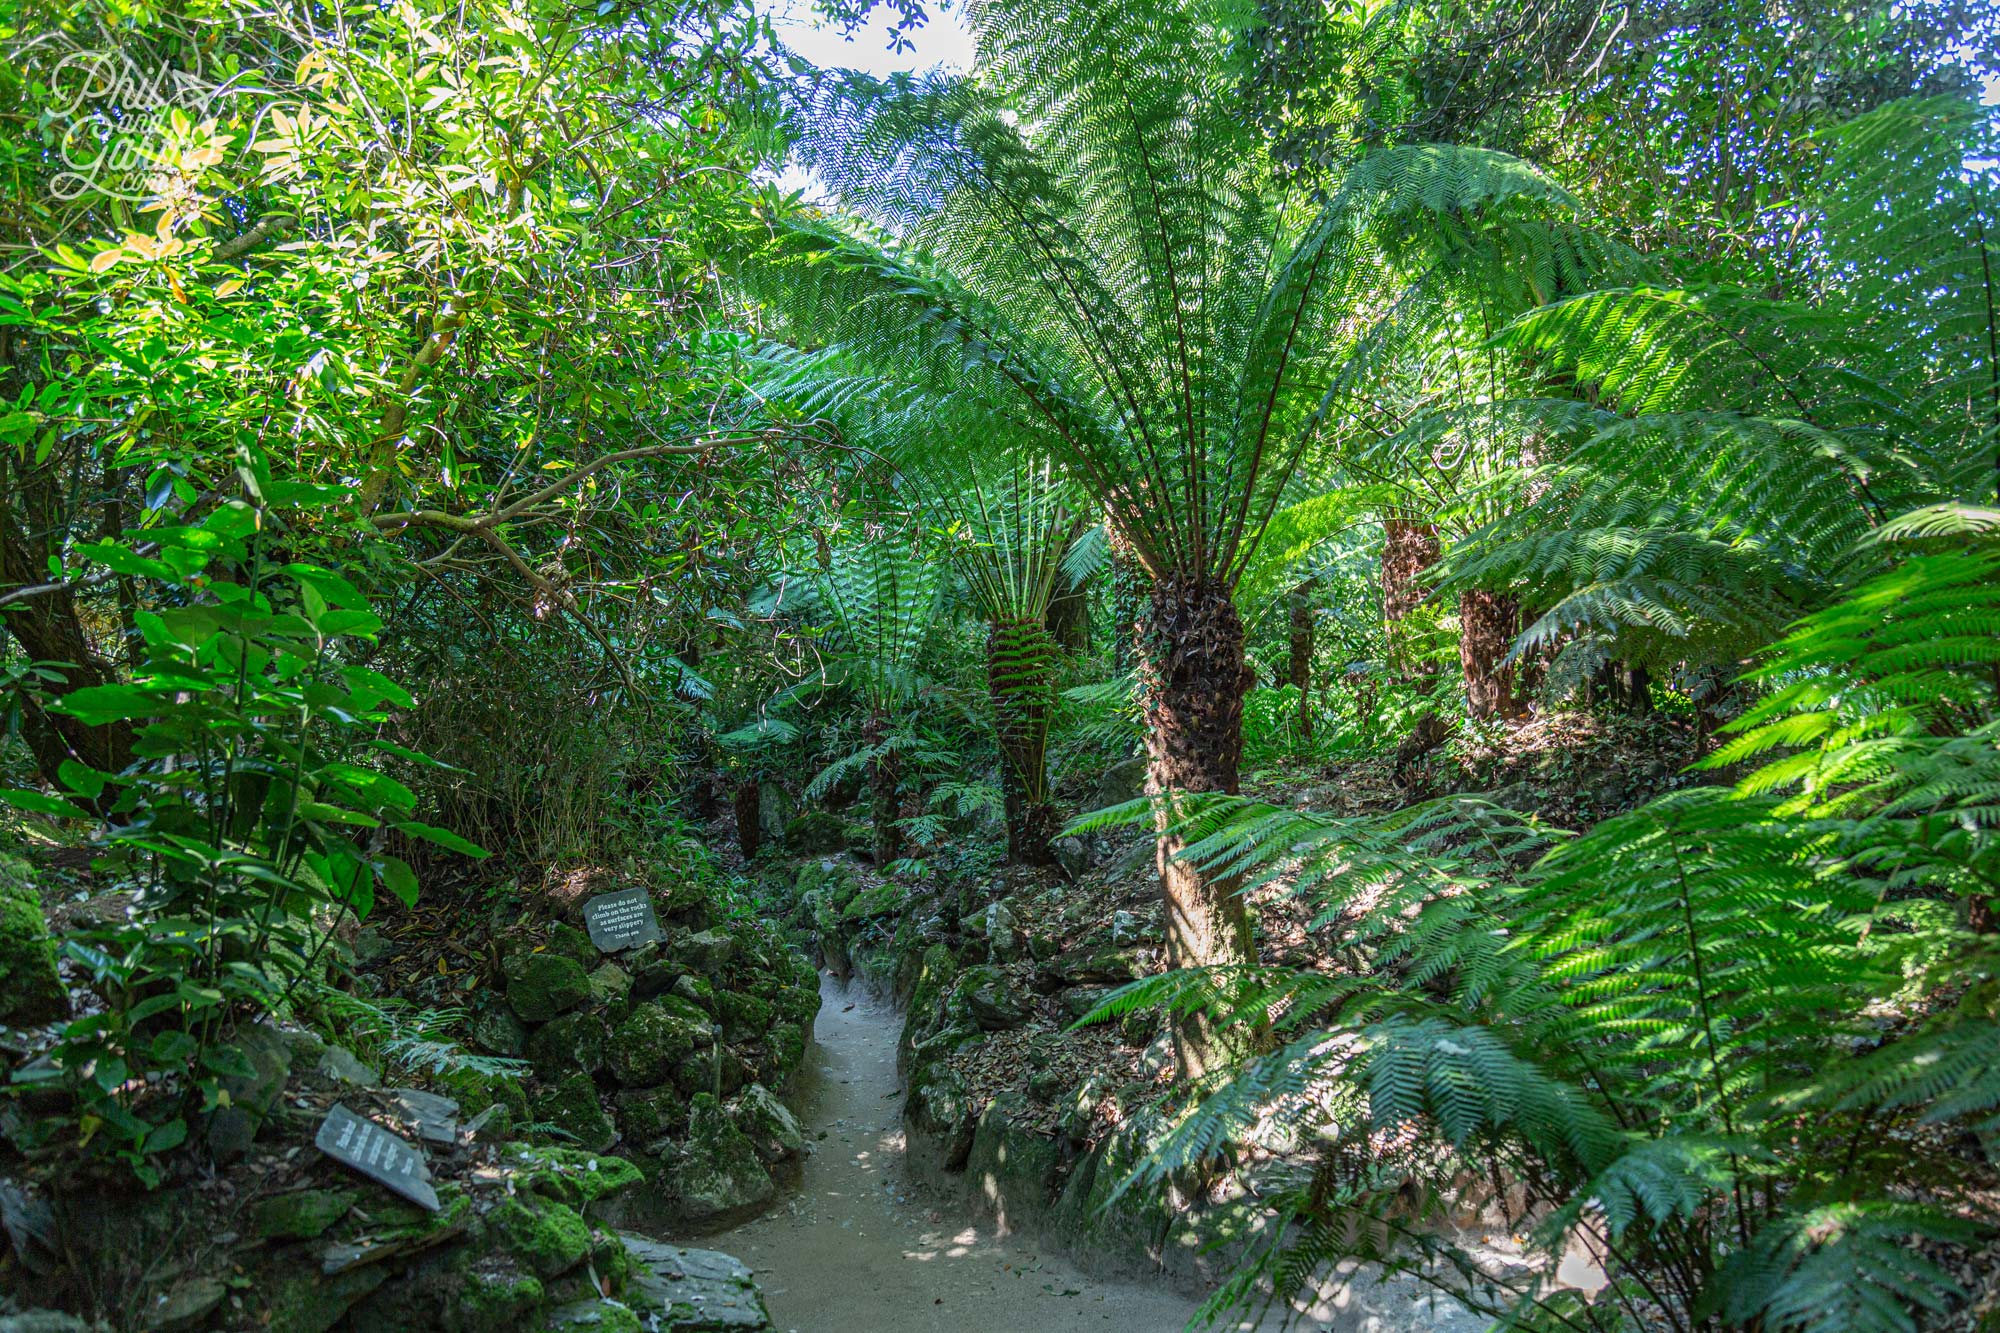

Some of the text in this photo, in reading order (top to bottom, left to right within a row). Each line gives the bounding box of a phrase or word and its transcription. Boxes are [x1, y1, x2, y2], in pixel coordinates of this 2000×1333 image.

[592, 910, 610, 920] climb
[630, 903, 647, 911] rocks
[597, 902, 617, 911] Please
[607, 914, 633, 924] surfaces
[618, 919, 644, 929] slippery
